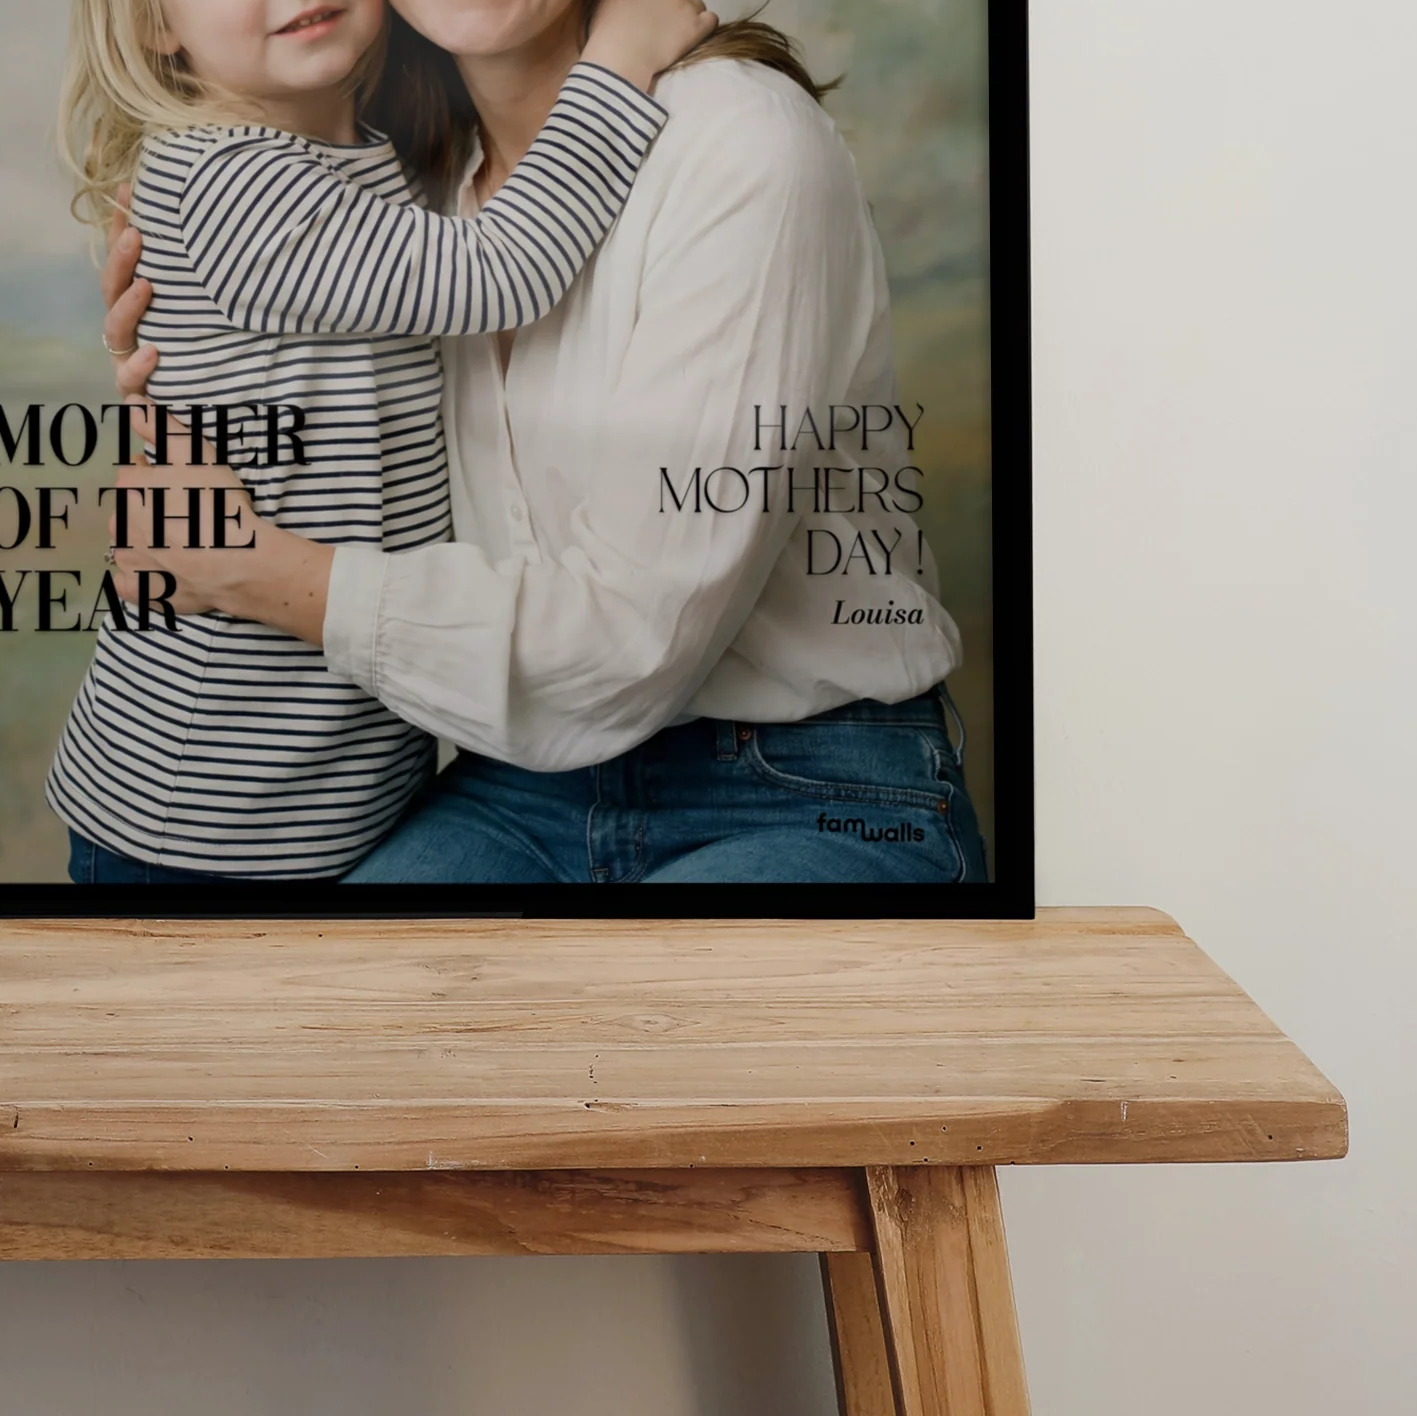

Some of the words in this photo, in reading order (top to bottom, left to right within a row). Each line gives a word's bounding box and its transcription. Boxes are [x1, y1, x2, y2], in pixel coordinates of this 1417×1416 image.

[754, 402, 924, 451] HAPPY
[659, 464, 924, 513] MOTHERS
[98, 486, 256, 549] THE
[831, 598, 924, 626] Louisa
[816, 812, 925, 842] famwalls
